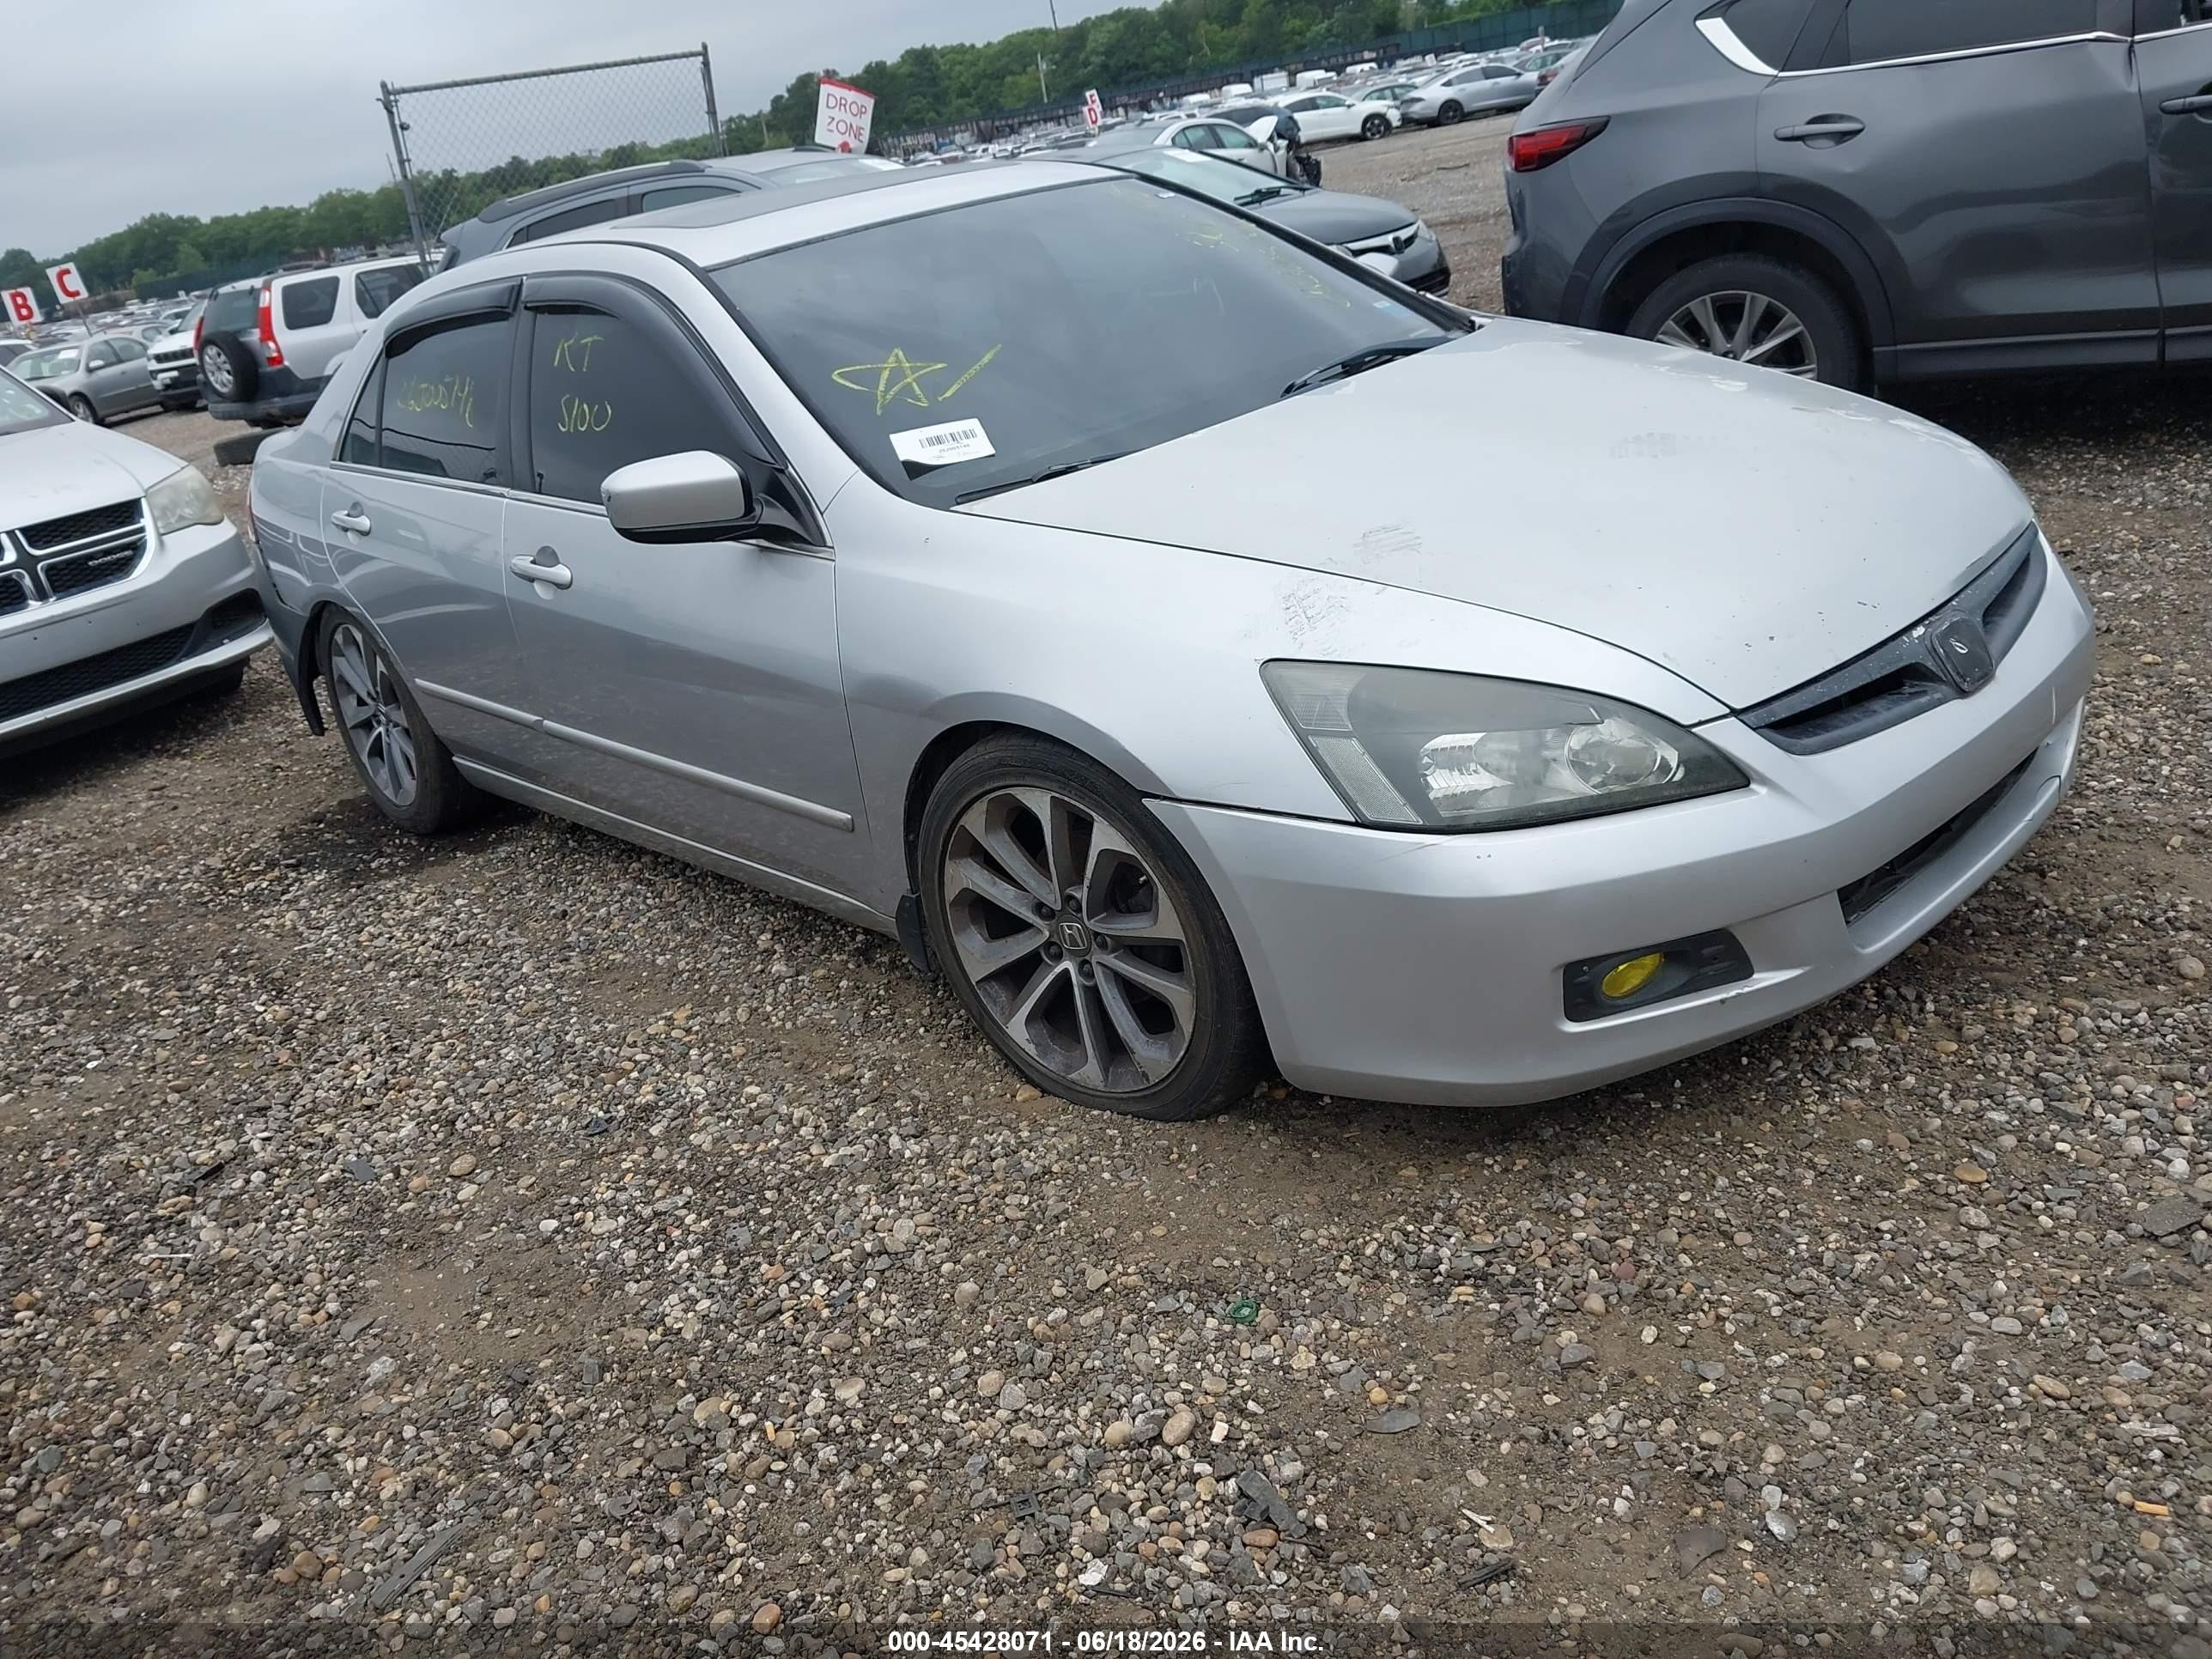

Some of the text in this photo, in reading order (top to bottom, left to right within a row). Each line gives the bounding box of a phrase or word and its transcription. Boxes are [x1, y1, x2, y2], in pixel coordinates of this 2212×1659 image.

[826, 93, 867, 119] DROP
[1088, 107, 1097, 125] D
[827, 115, 866, 143] ZONE
[57, 268, 82, 298] C
[9, 291, 33, 321] B
